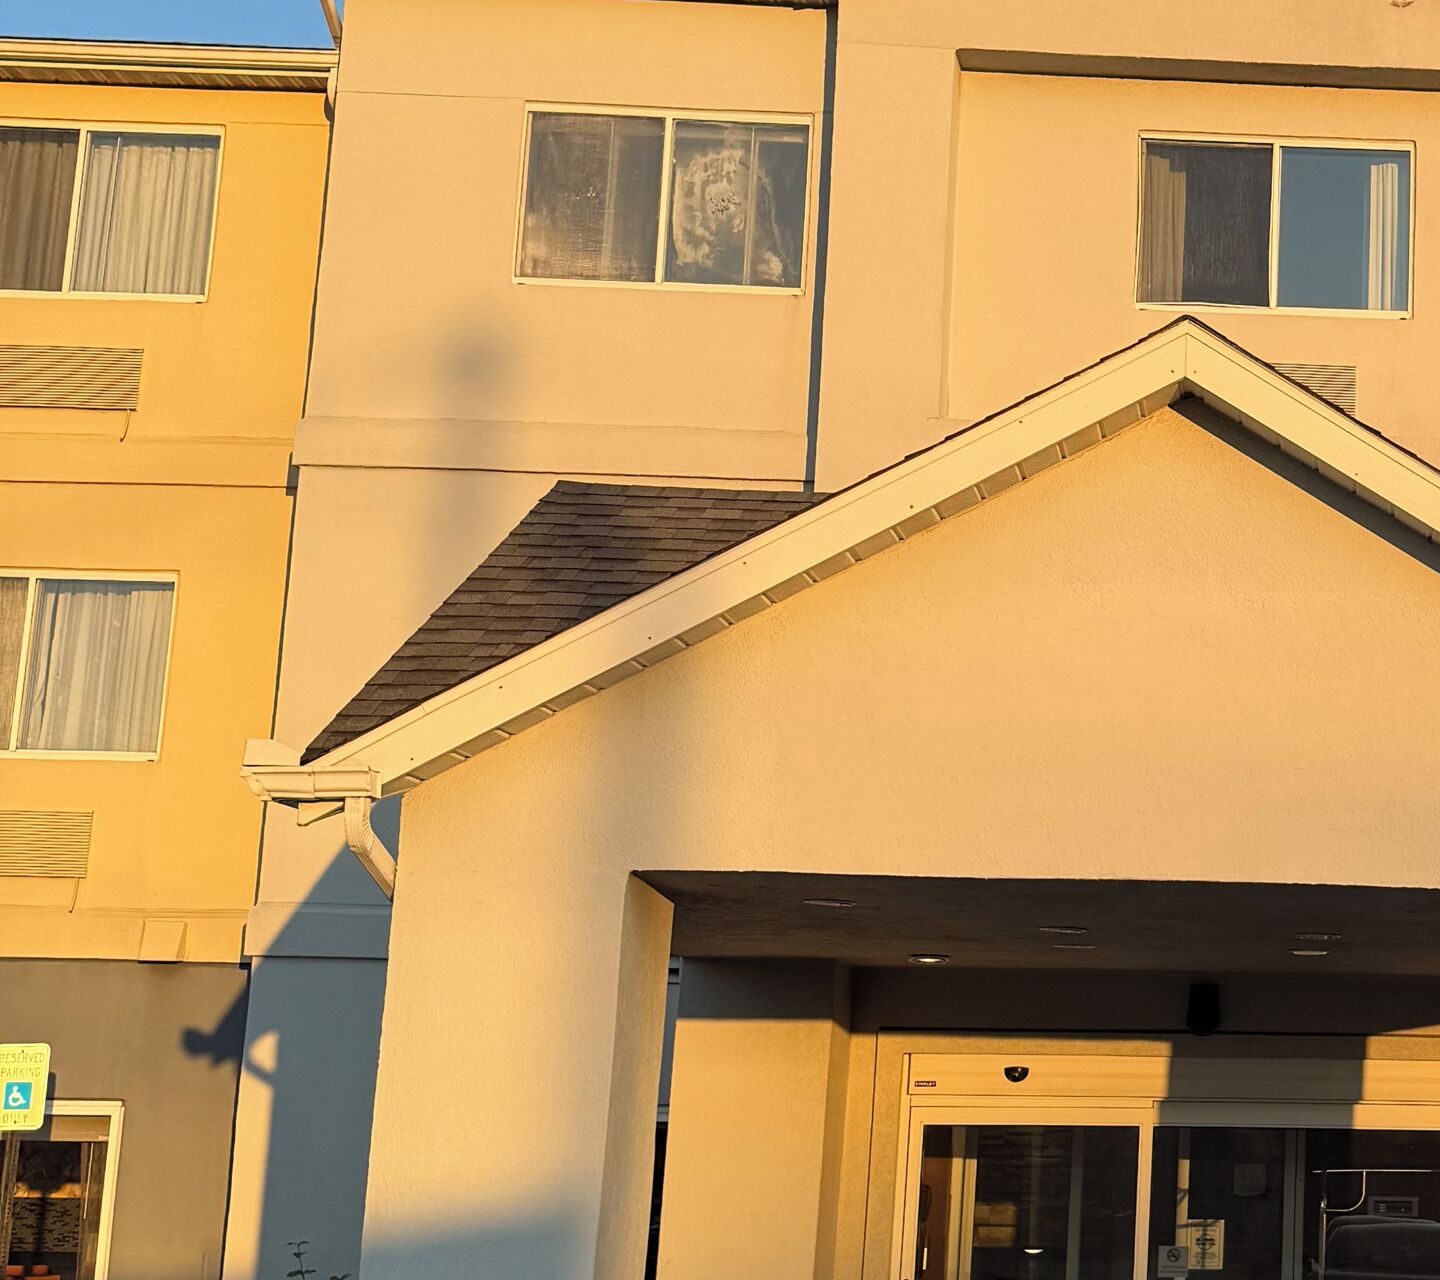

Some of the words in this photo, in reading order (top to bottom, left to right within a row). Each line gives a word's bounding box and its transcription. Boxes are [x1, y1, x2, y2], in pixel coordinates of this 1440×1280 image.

[0, 1052, 45, 1064] RESERVED
[0, 1066, 41, 1078] PARKING
[2, 1112, 28, 1124] ONLY
